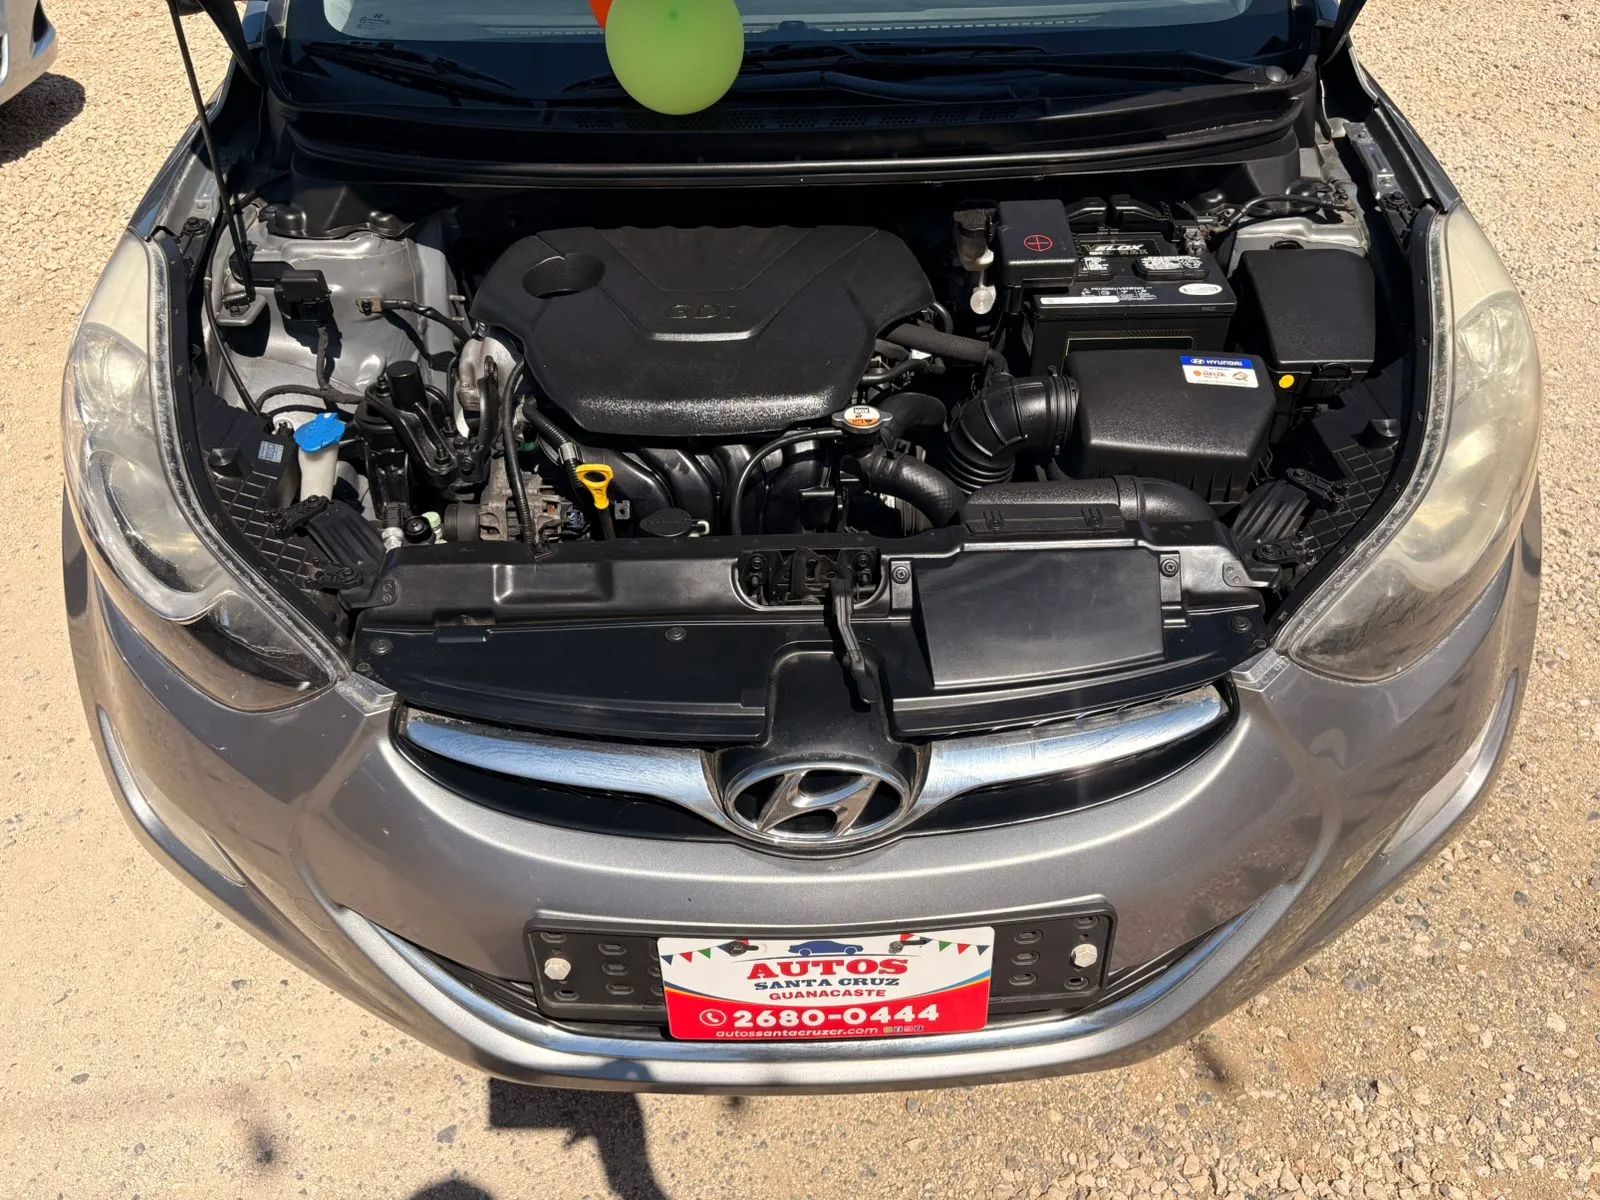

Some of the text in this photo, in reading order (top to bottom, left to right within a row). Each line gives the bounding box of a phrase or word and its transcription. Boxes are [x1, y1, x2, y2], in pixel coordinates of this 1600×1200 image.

[1206, 359, 1243, 367] HYUNDAI
[747, 958, 909, 980] AUTOS
[754, 977, 900, 991] SANTA CRUZ
[769, 989, 886, 1001] GUANACASTE
[733, 1003, 939, 1028] 2680-0444
[715, 1026, 879, 1038] autossantacruzcr.com
